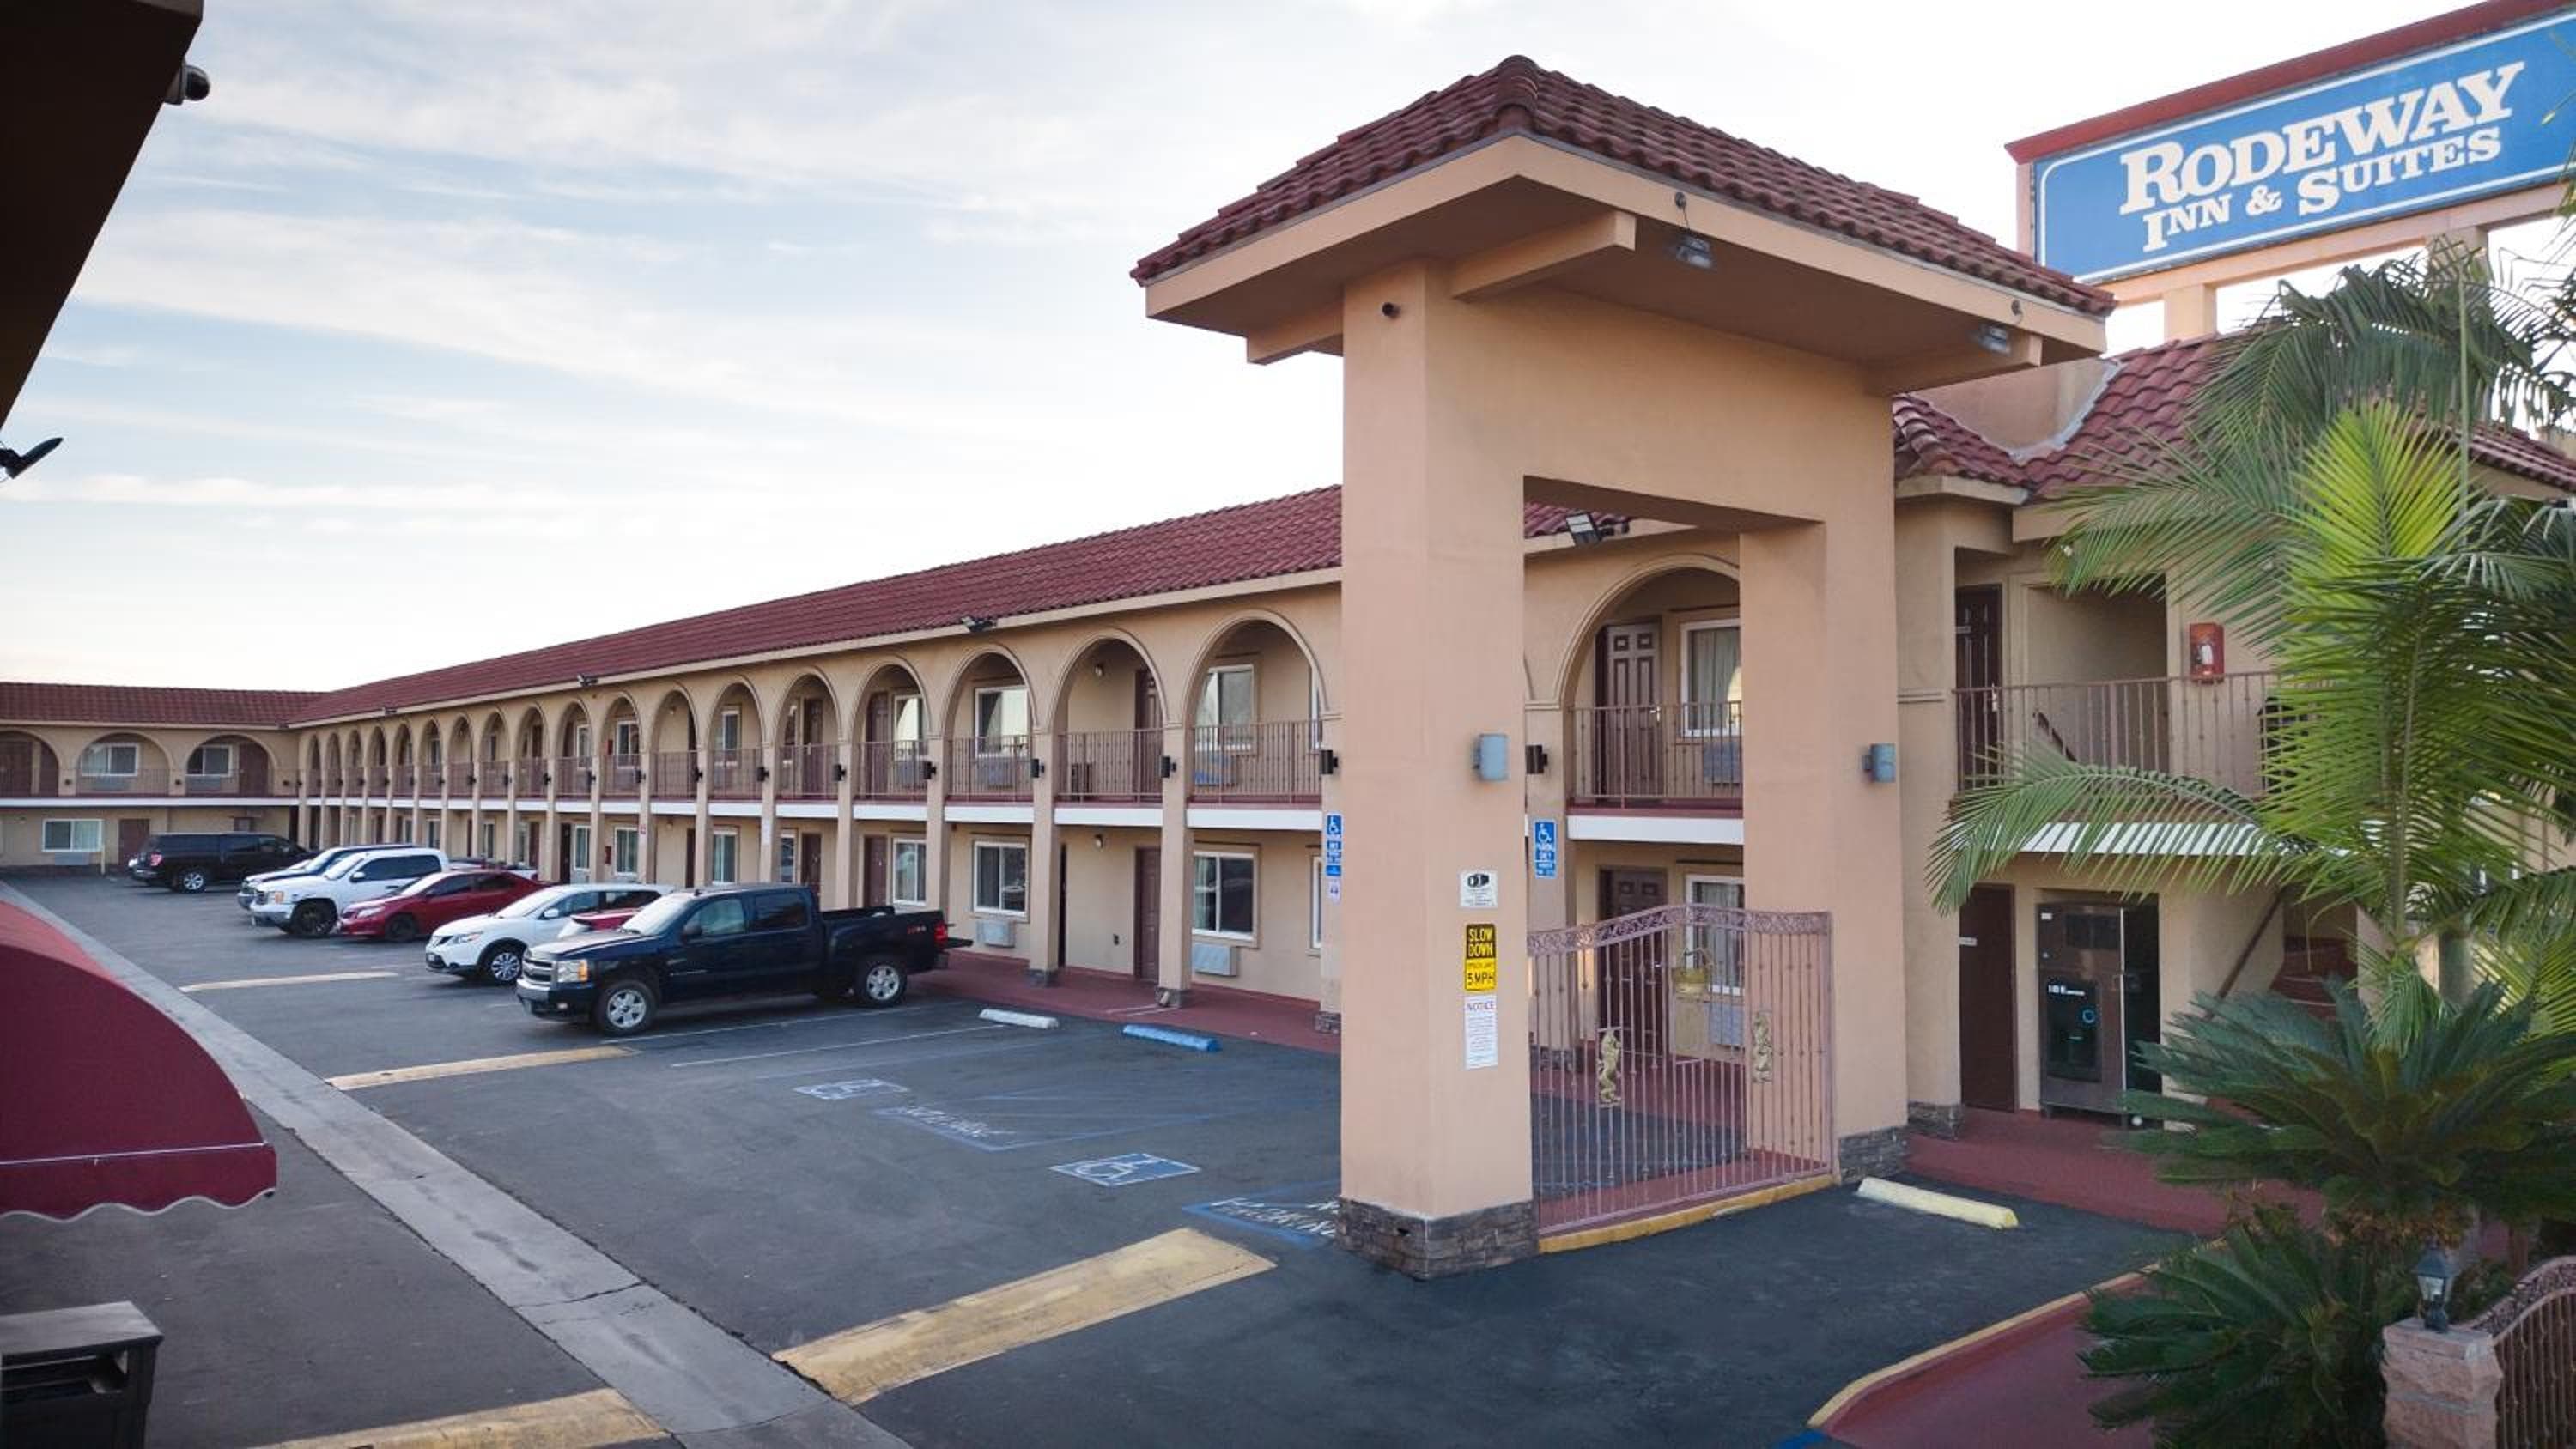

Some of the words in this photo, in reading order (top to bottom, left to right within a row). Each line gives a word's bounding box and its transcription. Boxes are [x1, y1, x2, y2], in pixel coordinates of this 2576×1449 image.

[2119, 61, 2524, 215] RODEWAY
[2142, 193, 2233, 252] INN
[2245, 185, 2283, 216] &
[2297, 127, 2501, 216] SUITES
[1468, 927, 1492, 943] SLOW
[1467, 942, 1493, 957] DOWN
[1467, 1000, 1495, 1011] NOTICE
